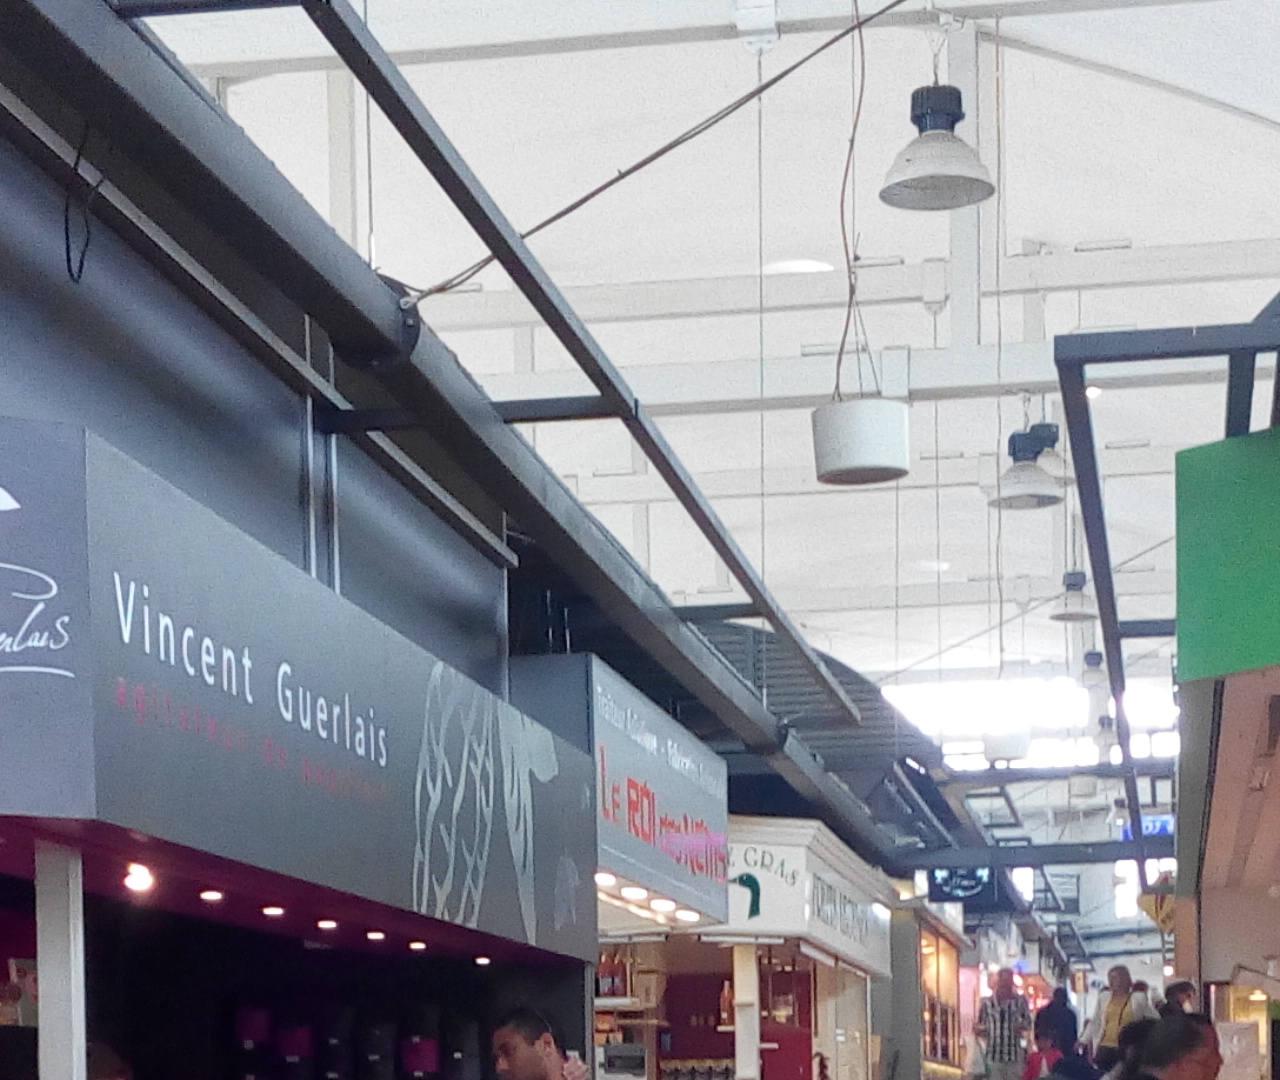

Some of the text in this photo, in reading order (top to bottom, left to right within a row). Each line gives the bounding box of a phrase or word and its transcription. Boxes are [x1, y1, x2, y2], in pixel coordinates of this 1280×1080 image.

[113, 570, 388, 768] Vincent Guerlais
[743, 847, 799, 887] GRAS
